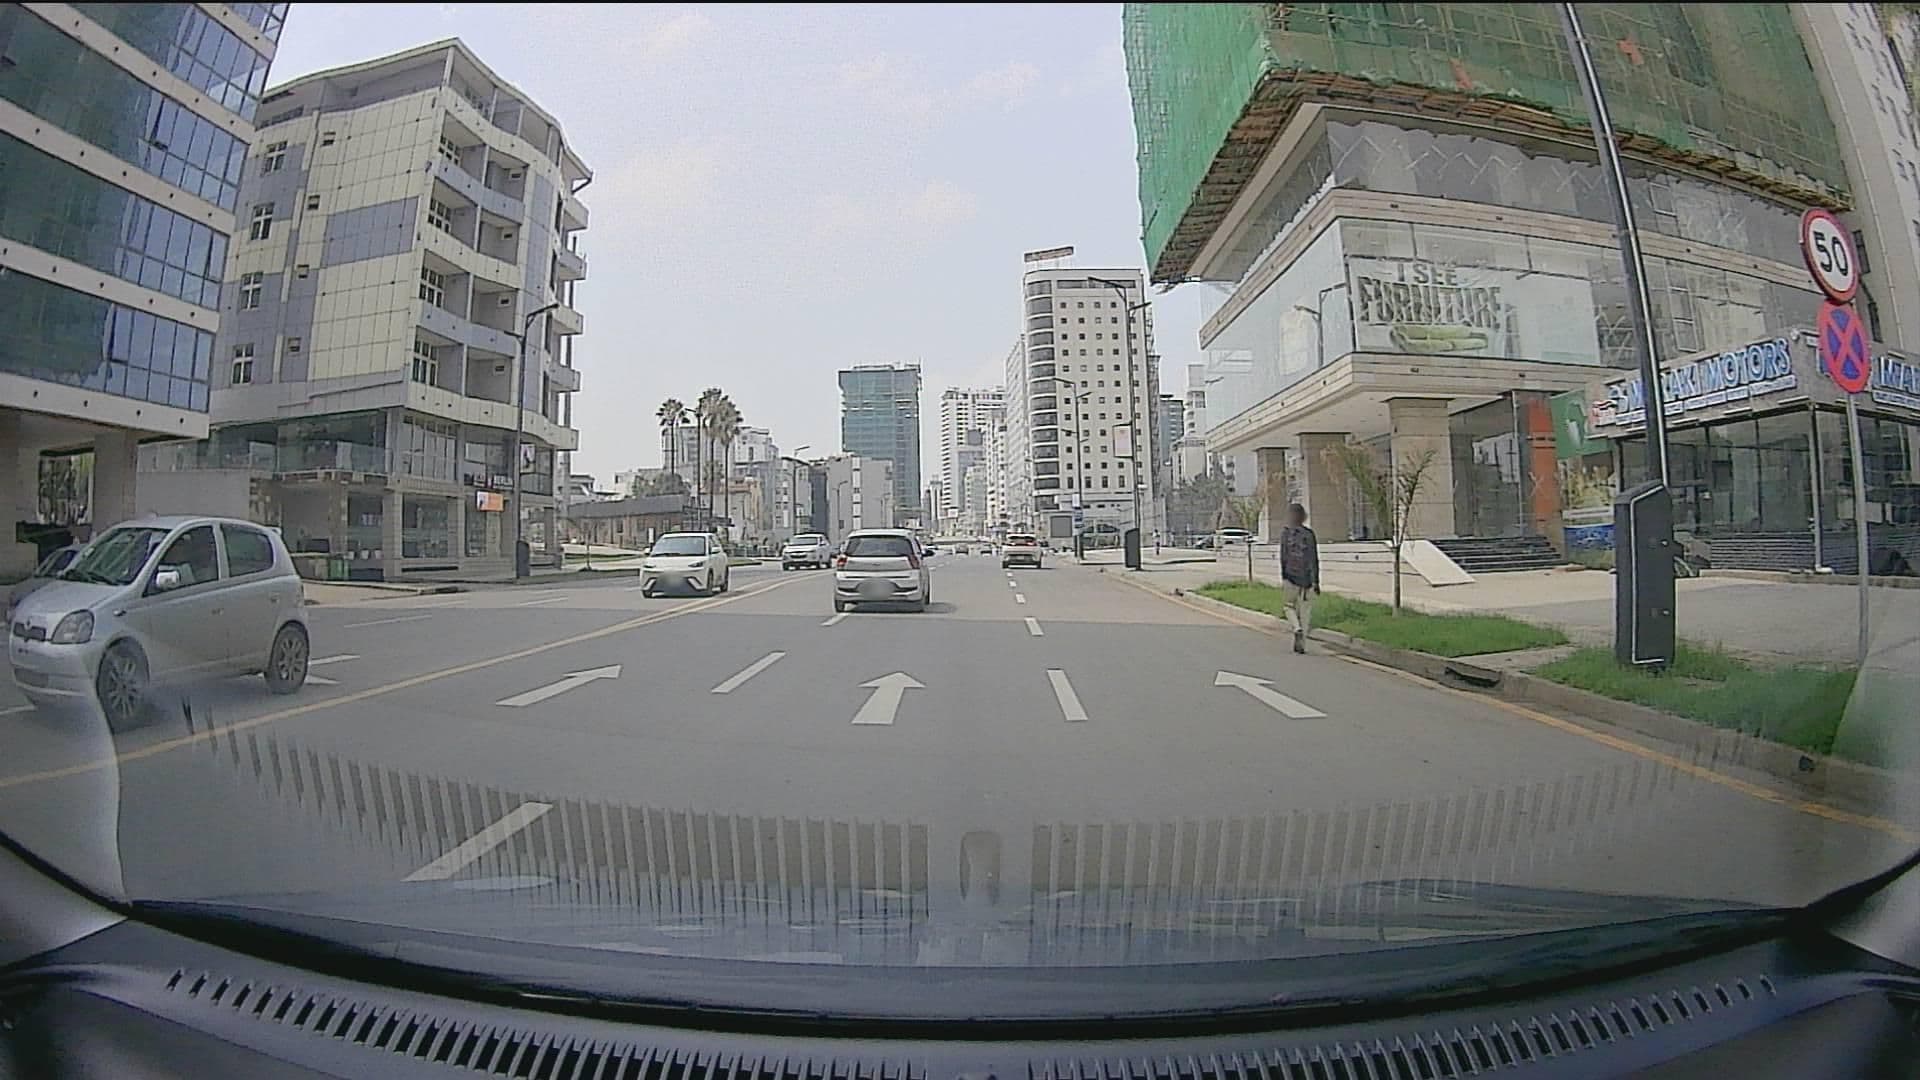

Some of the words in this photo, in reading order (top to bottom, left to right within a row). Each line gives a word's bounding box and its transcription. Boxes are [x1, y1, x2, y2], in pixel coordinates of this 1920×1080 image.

[1413, 261, 1458, 286] SEE
[1813, 231, 1848, 275] 50
[1358, 276, 1501, 328] FURNITURE
[1702, 338, 1791, 388] MOTORS
